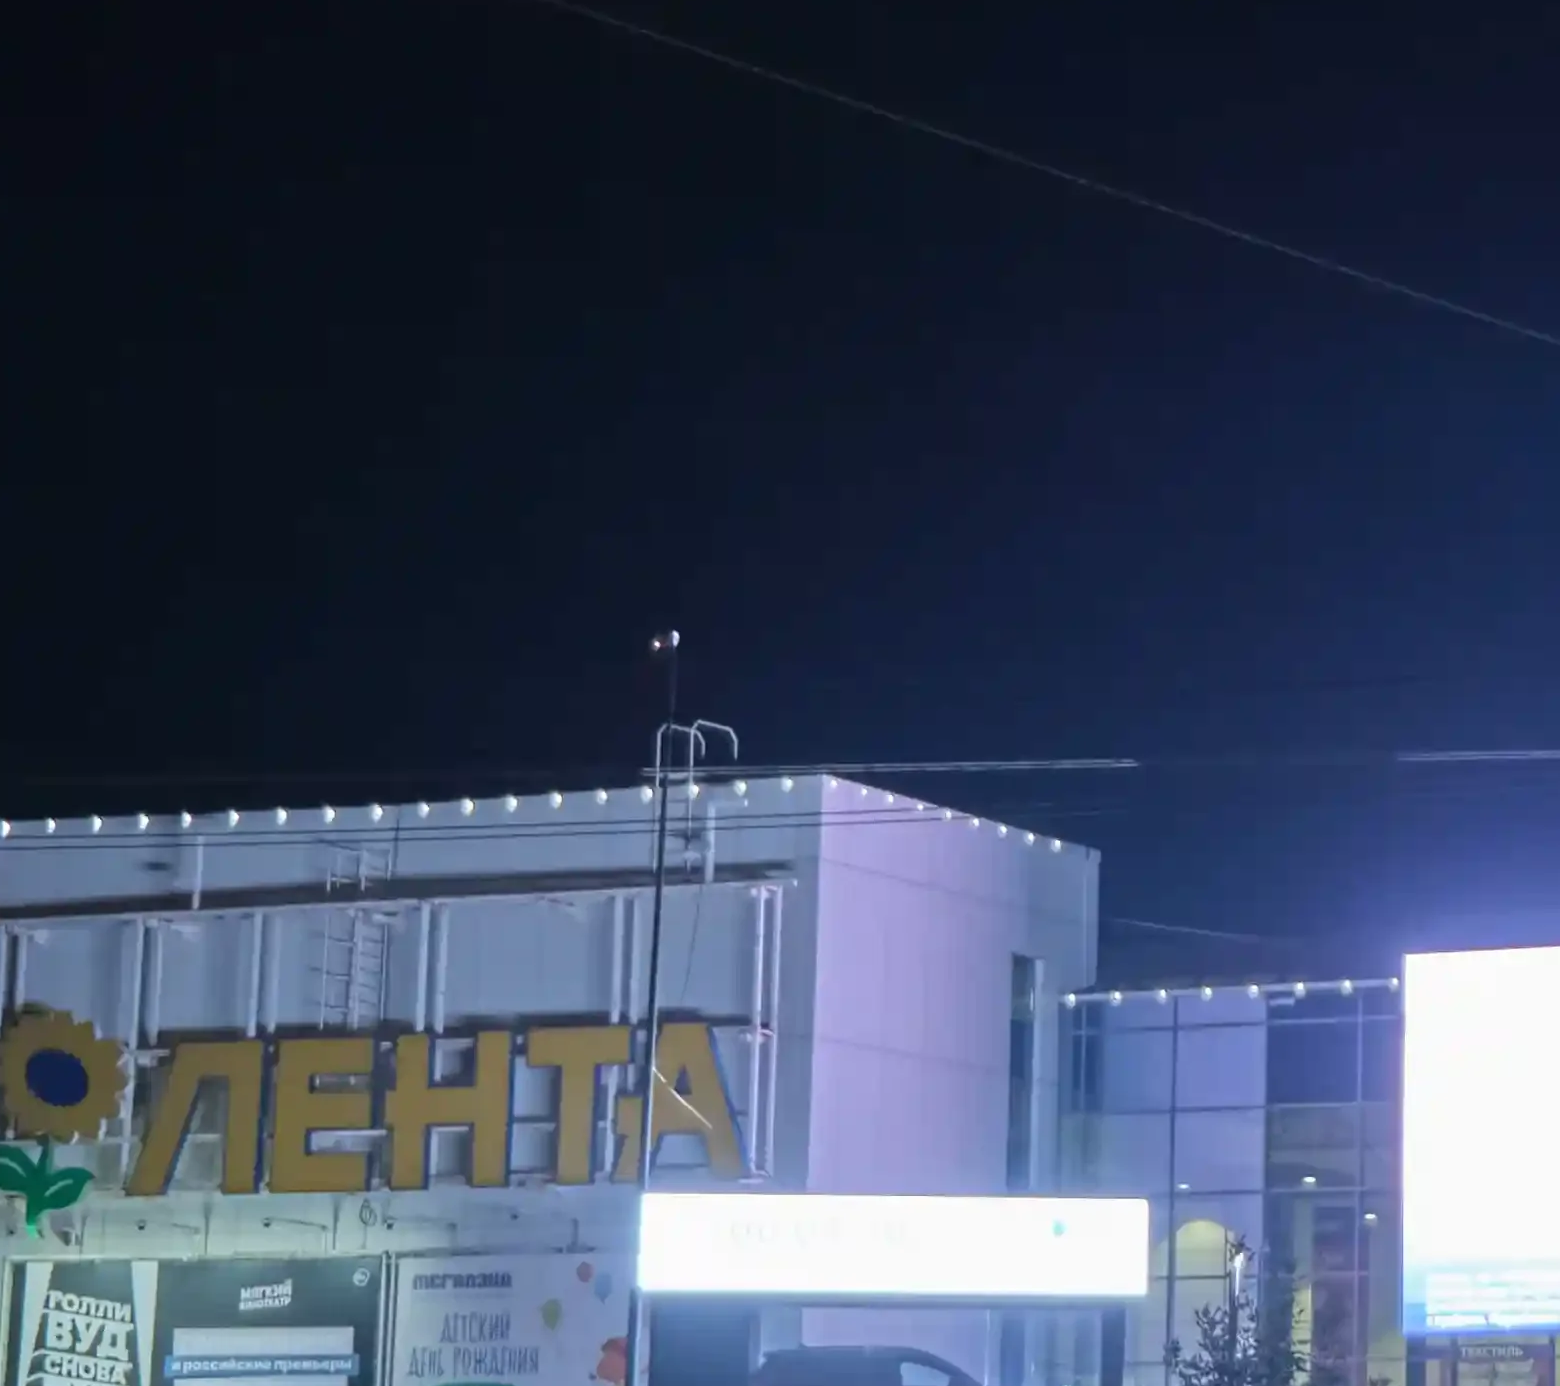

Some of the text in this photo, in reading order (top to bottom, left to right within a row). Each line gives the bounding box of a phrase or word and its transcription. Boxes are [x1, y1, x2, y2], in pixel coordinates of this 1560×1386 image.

[125, 1021, 752, 1197] ЛЕНТА
[46, 1311, 134, 1361] ВУД
[44, 1350, 133, 1385] СНОВА
